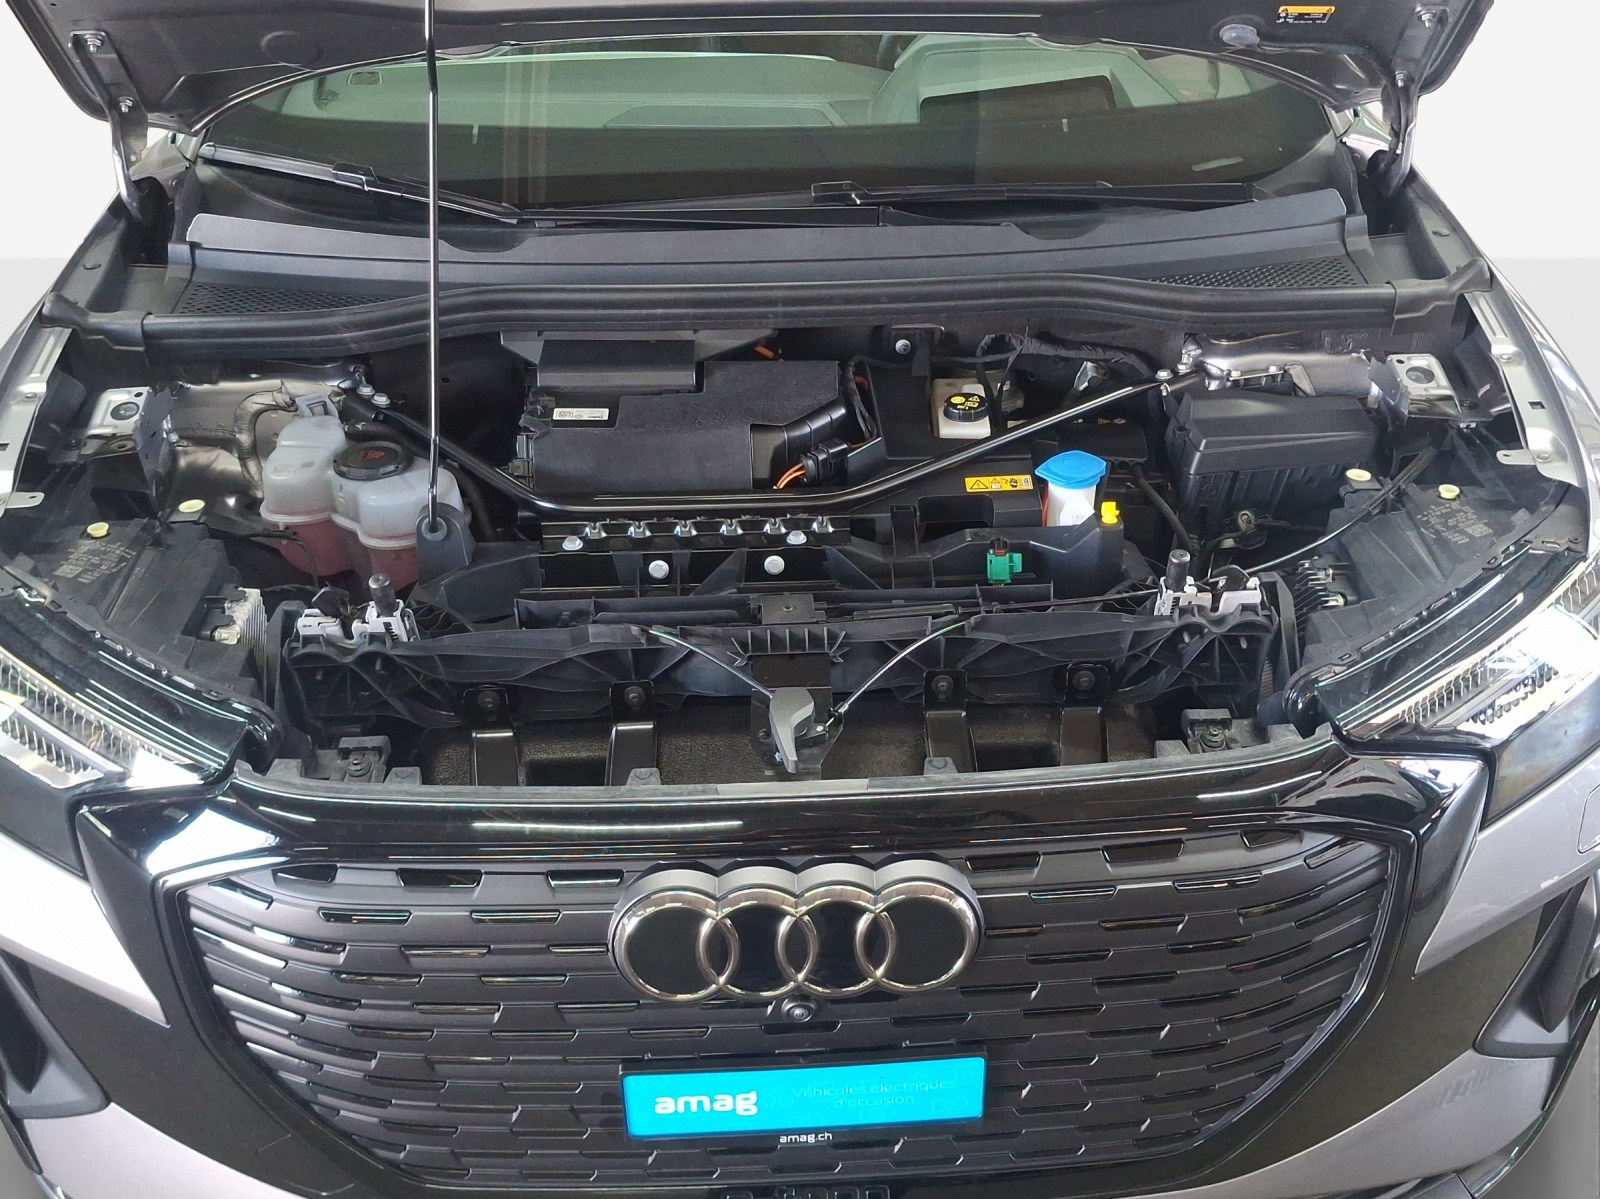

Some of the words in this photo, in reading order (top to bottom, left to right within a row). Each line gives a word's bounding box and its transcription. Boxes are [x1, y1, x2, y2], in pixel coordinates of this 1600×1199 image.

[654, 1091, 758, 1116] amag
[833, 1096, 915, 1108] d'occasion
[779, 1132, 833, 1143] amag.ch
